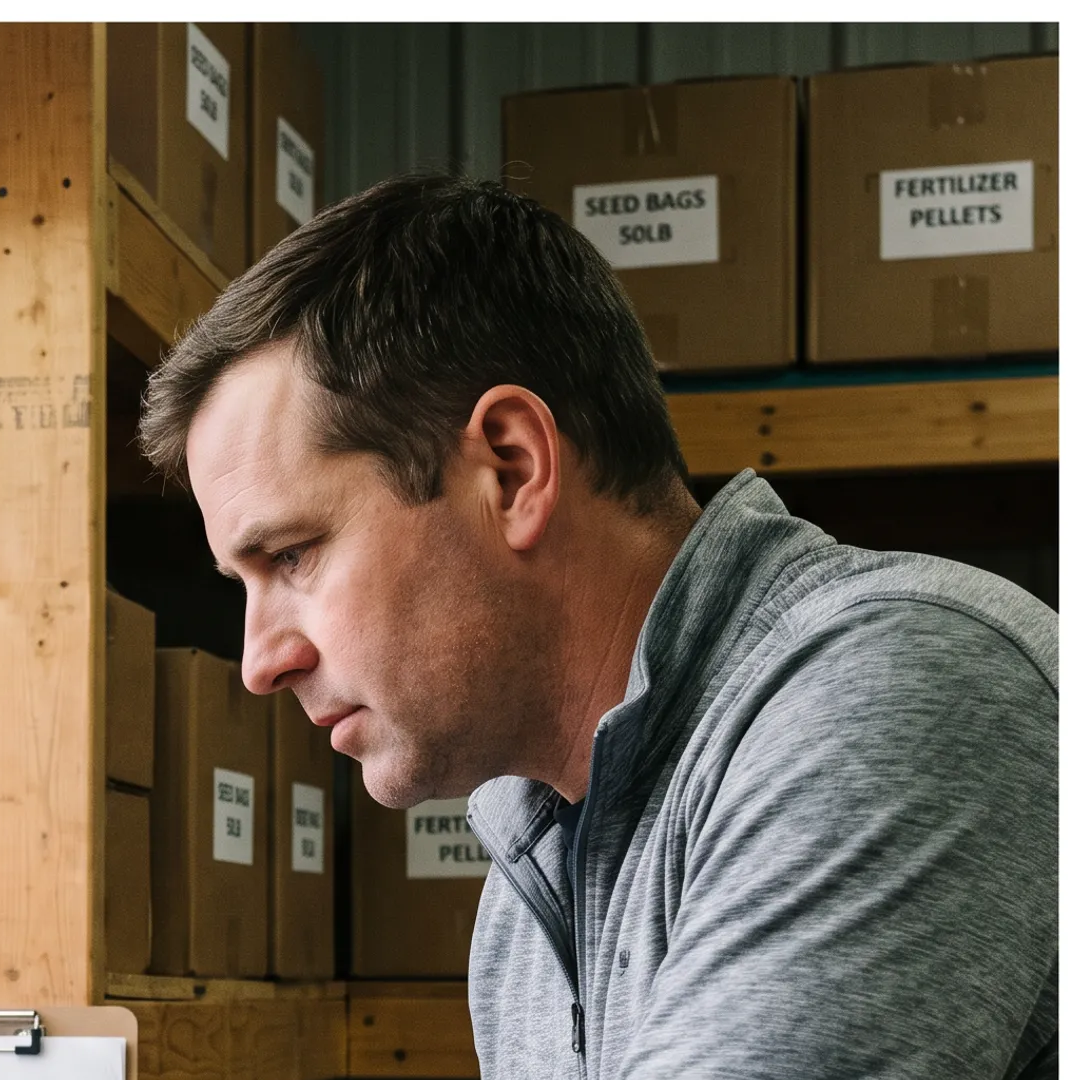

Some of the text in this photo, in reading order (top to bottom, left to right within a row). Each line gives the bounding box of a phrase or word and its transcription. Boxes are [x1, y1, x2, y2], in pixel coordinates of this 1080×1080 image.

[894, 171, 1018, 198] FERTILIZER
[585, 188, 706, 216] SEED BAGS
[909, 203, 1003, 228] PELLETS
[619, 222, 673, 246] 50LB
[439, 843, 493, 863] PELL
